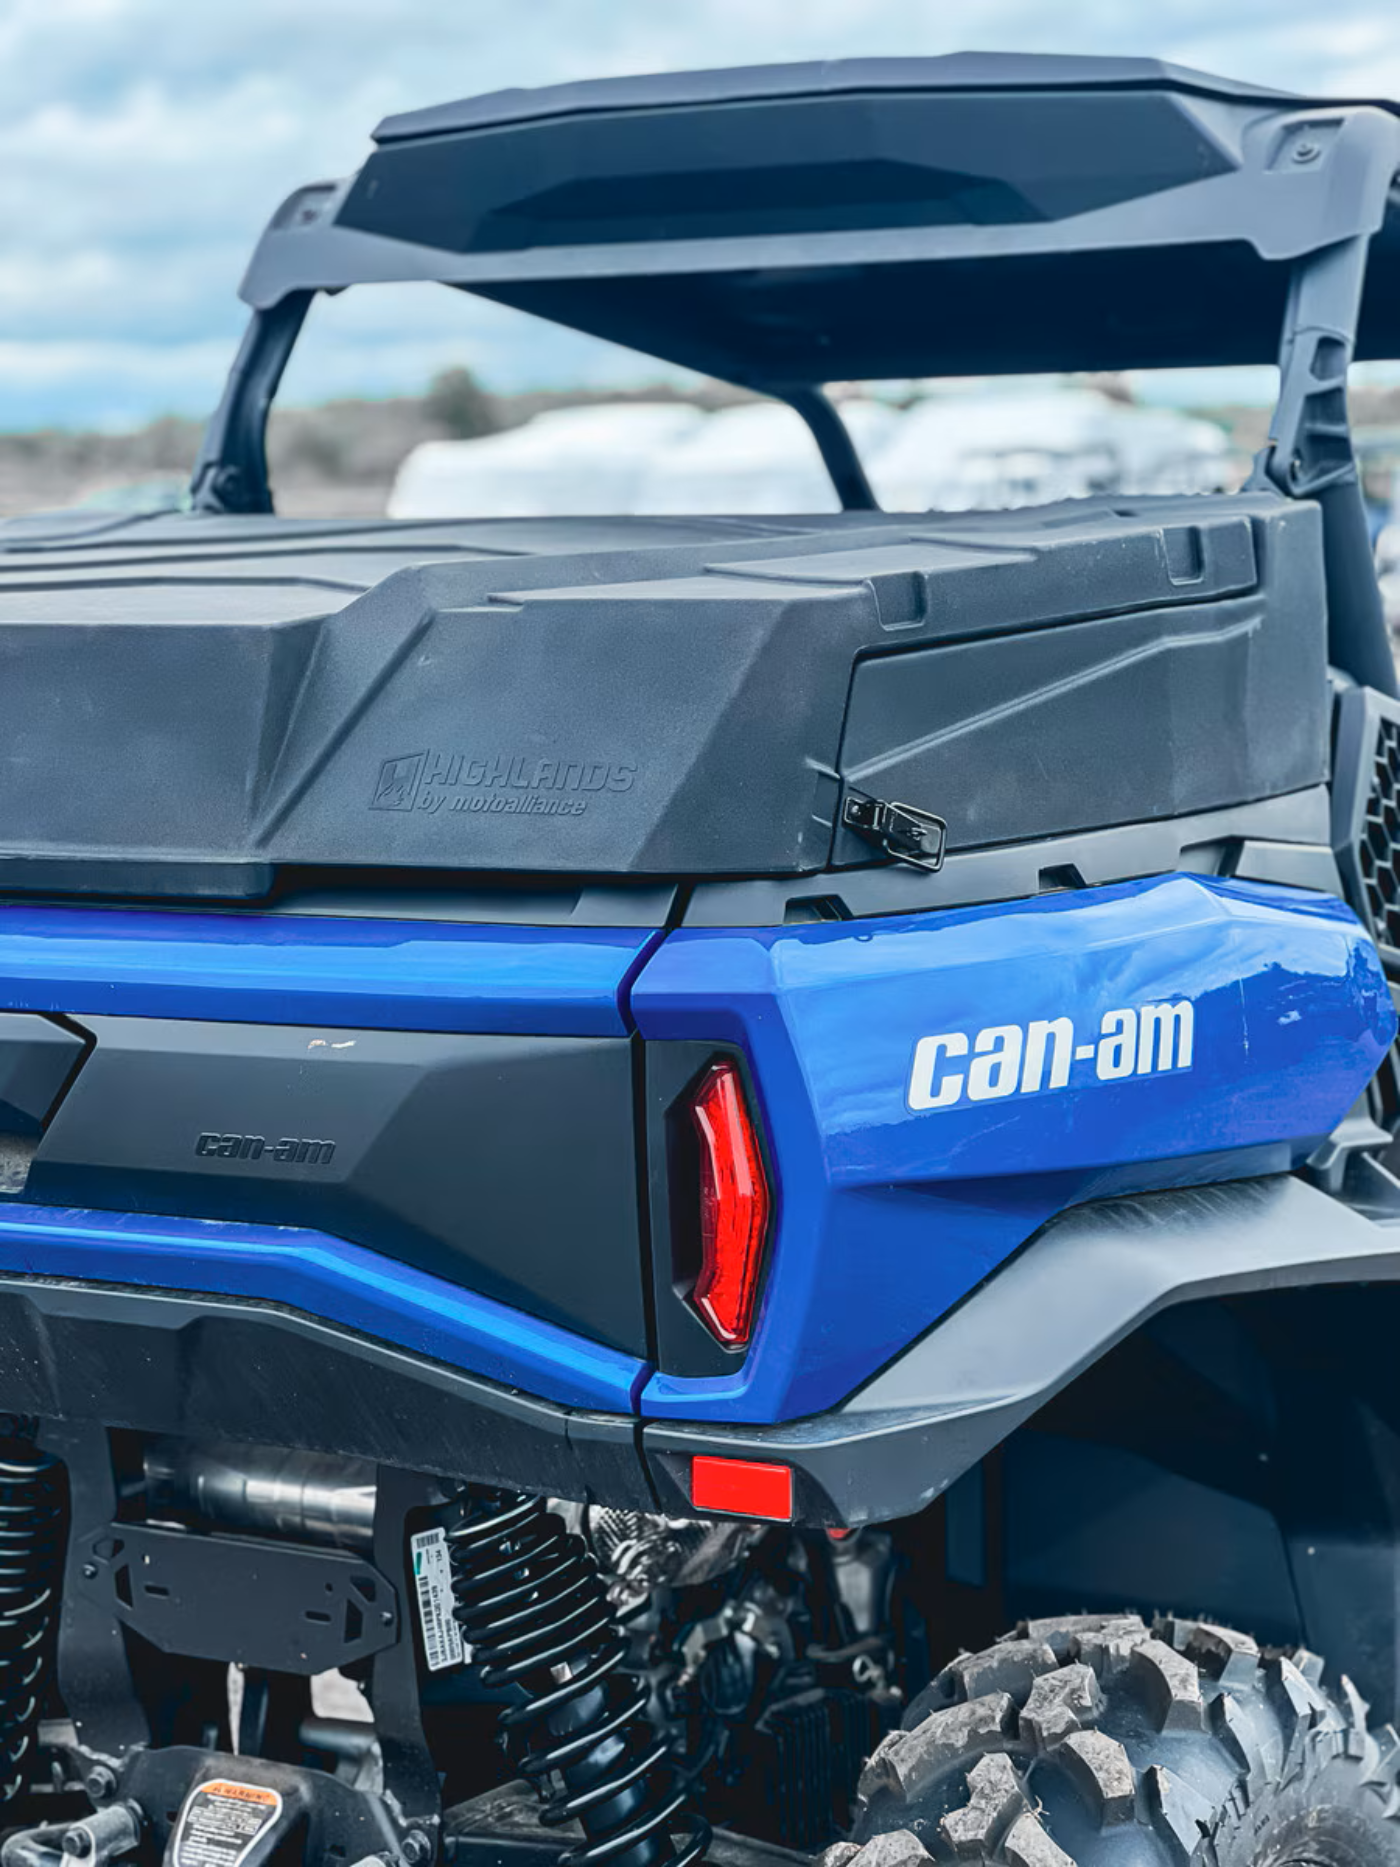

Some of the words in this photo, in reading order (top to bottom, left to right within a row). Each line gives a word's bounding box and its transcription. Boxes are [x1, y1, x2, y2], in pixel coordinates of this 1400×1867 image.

[424, 752, 638, 792] HIGHLANDS
[417, 791, 446, 814] by
[450, 793, 587, 815] motoalliance
[908, 1000, 1194, 1111] can-am
[195, 1132, 336, 1164] can-am
